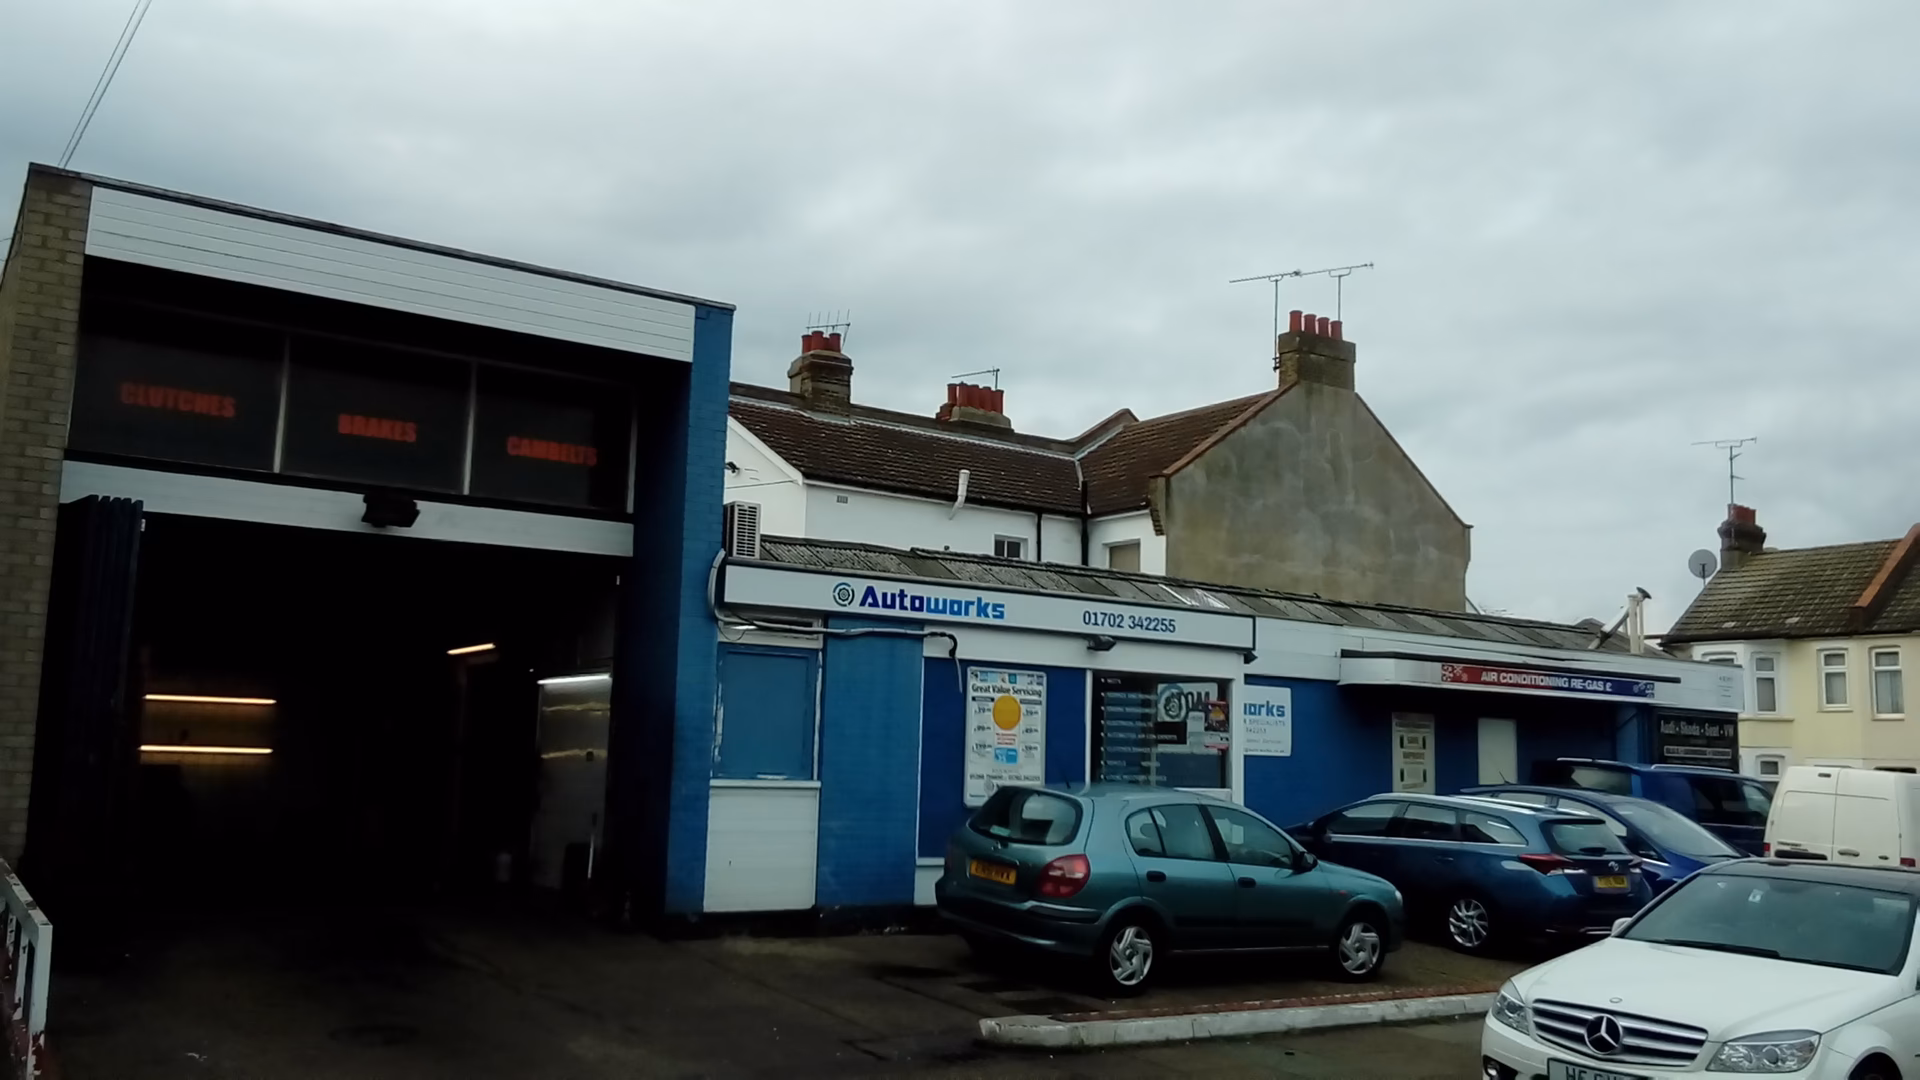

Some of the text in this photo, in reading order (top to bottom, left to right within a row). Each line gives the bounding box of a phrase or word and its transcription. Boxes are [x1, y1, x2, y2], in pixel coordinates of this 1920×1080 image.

[120, 382, 236, 418] CLUTCHES
[338, 413, 417, 442] BRAKES
[506, 436, 597, 466] CAMBELTS
[859, 585, 1005, 620] Autoworks
[1082, 610, 1176, 634] 01702 342255
[971, 683, 1042, 698] Great Value Servicing
[1481, 671, 1498, 682] AIR
[1499, 672, 1569, 688] CONDITIONING
[1570, 679, 1604, 691] RE-GAS
